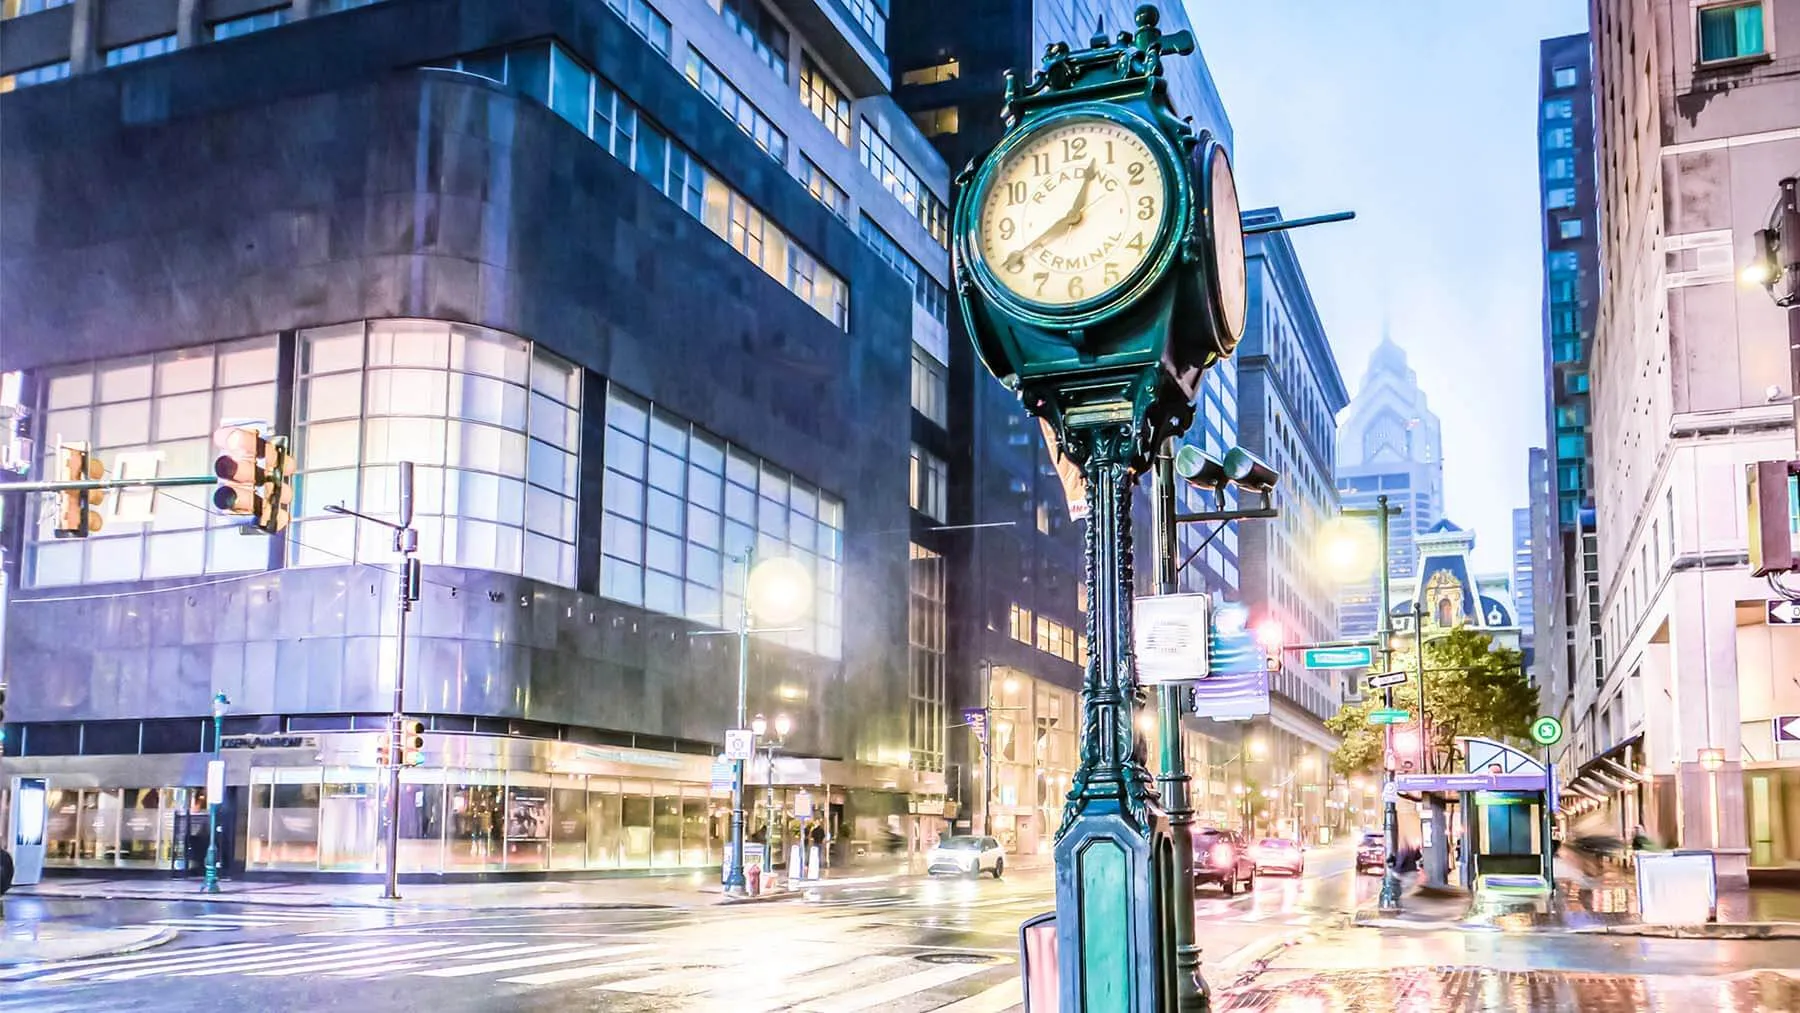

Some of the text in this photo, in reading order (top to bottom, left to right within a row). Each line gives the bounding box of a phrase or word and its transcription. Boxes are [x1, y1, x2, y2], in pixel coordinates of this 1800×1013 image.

[1062, 137, 1087, 163] 12
[1105, 141, 1115, 164] 1
[1033, 153, 1050, 176] 11
[1127, 162, 1145, 186] 2
[1008, 181, 1027, 205] 10
[1137, 196, 1155, 220] 3
[999, 216, 1016, 240] 9
[1125, 232, 1147, 257] 4
[1033, 272, 1050, 296] 7
[1103, 263, 1120, 287] 5
[1067, 276, 1085, 299] 6
